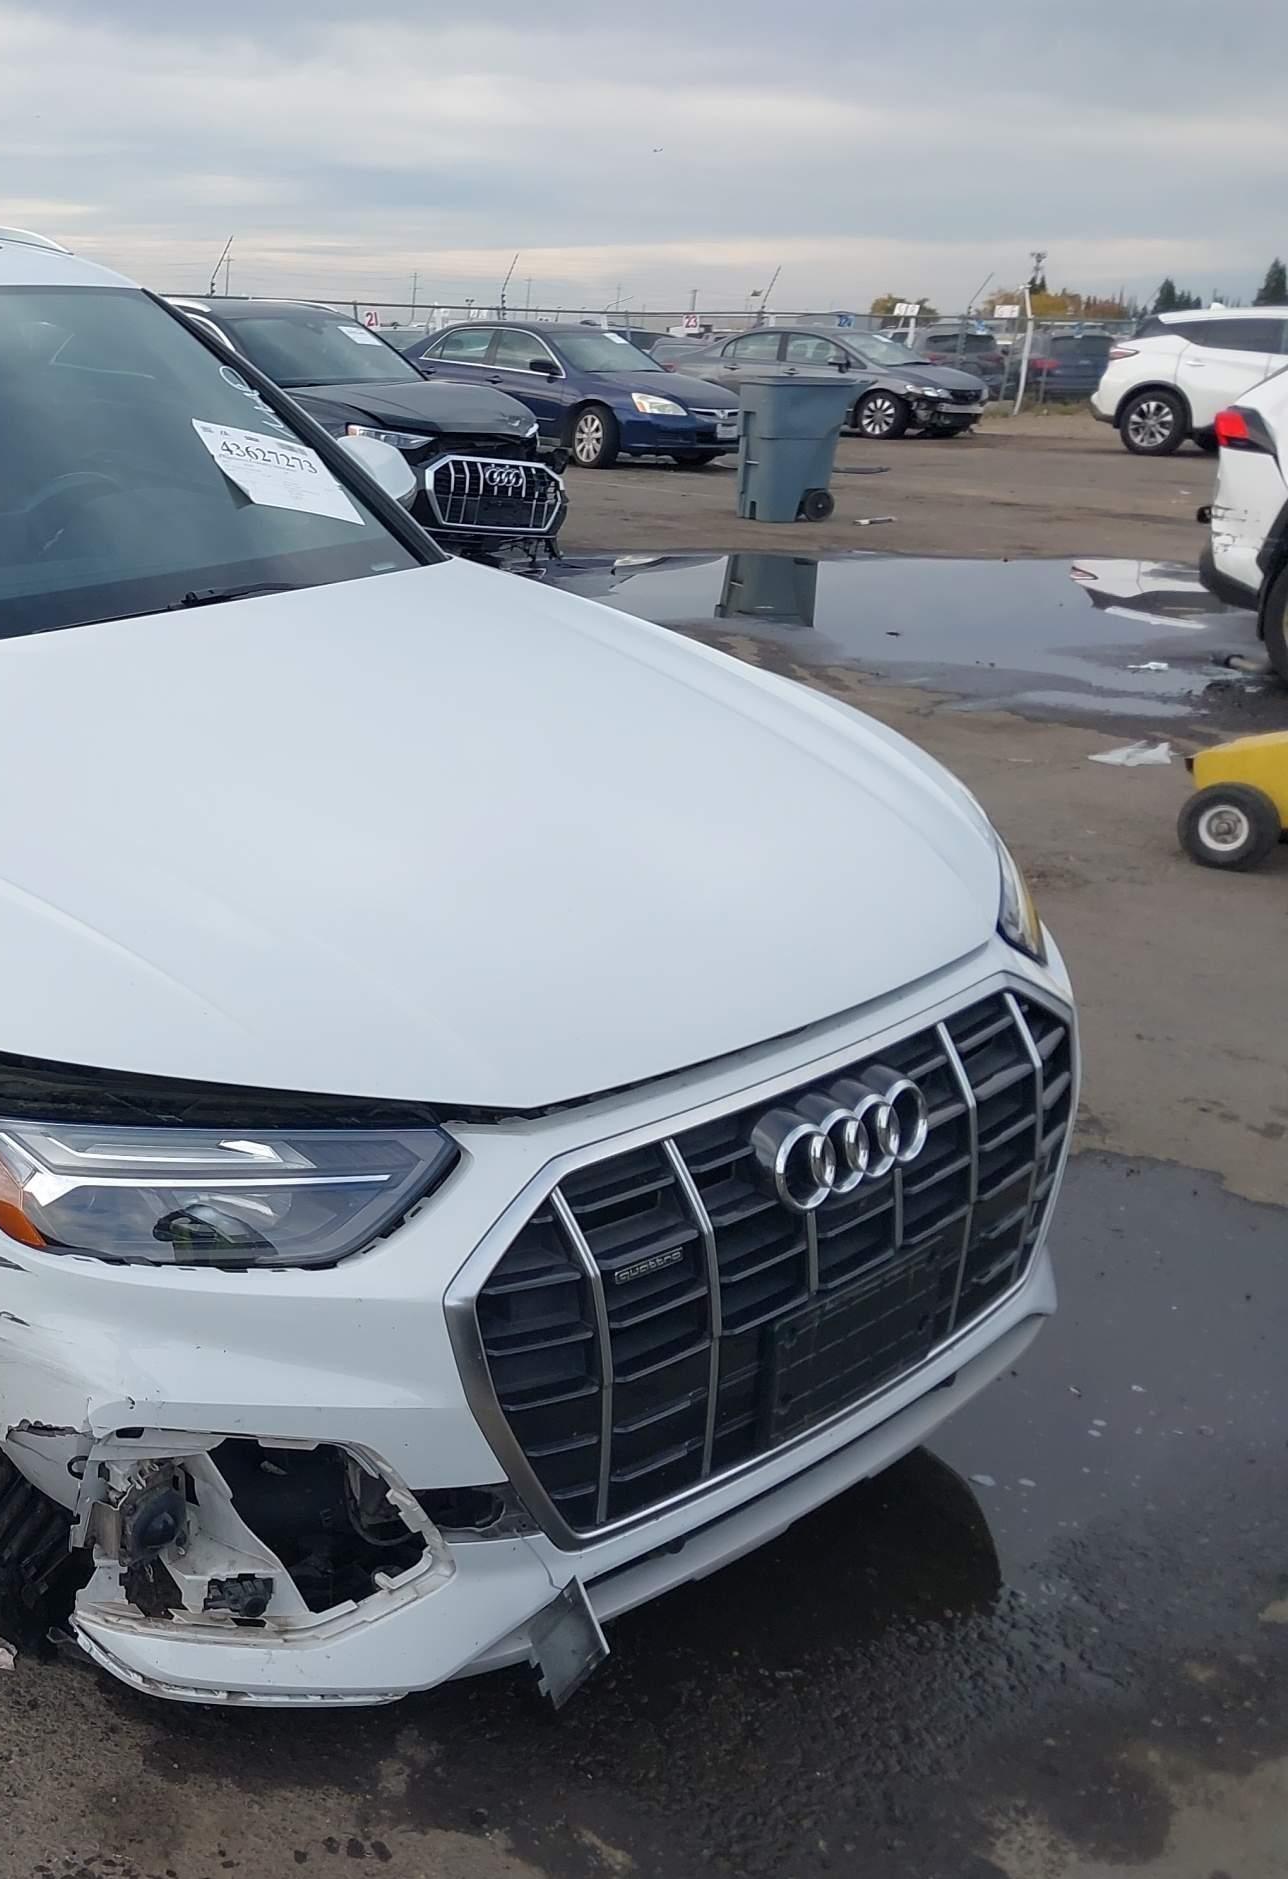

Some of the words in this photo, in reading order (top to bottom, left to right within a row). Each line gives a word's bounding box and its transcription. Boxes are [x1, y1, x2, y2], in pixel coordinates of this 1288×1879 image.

[365, 311, 379, 327] 21
[685, 315, 697, 328] 23
[220, 440, 318, 474] 43627273
[618, 1251, 681, 1282] quattro
